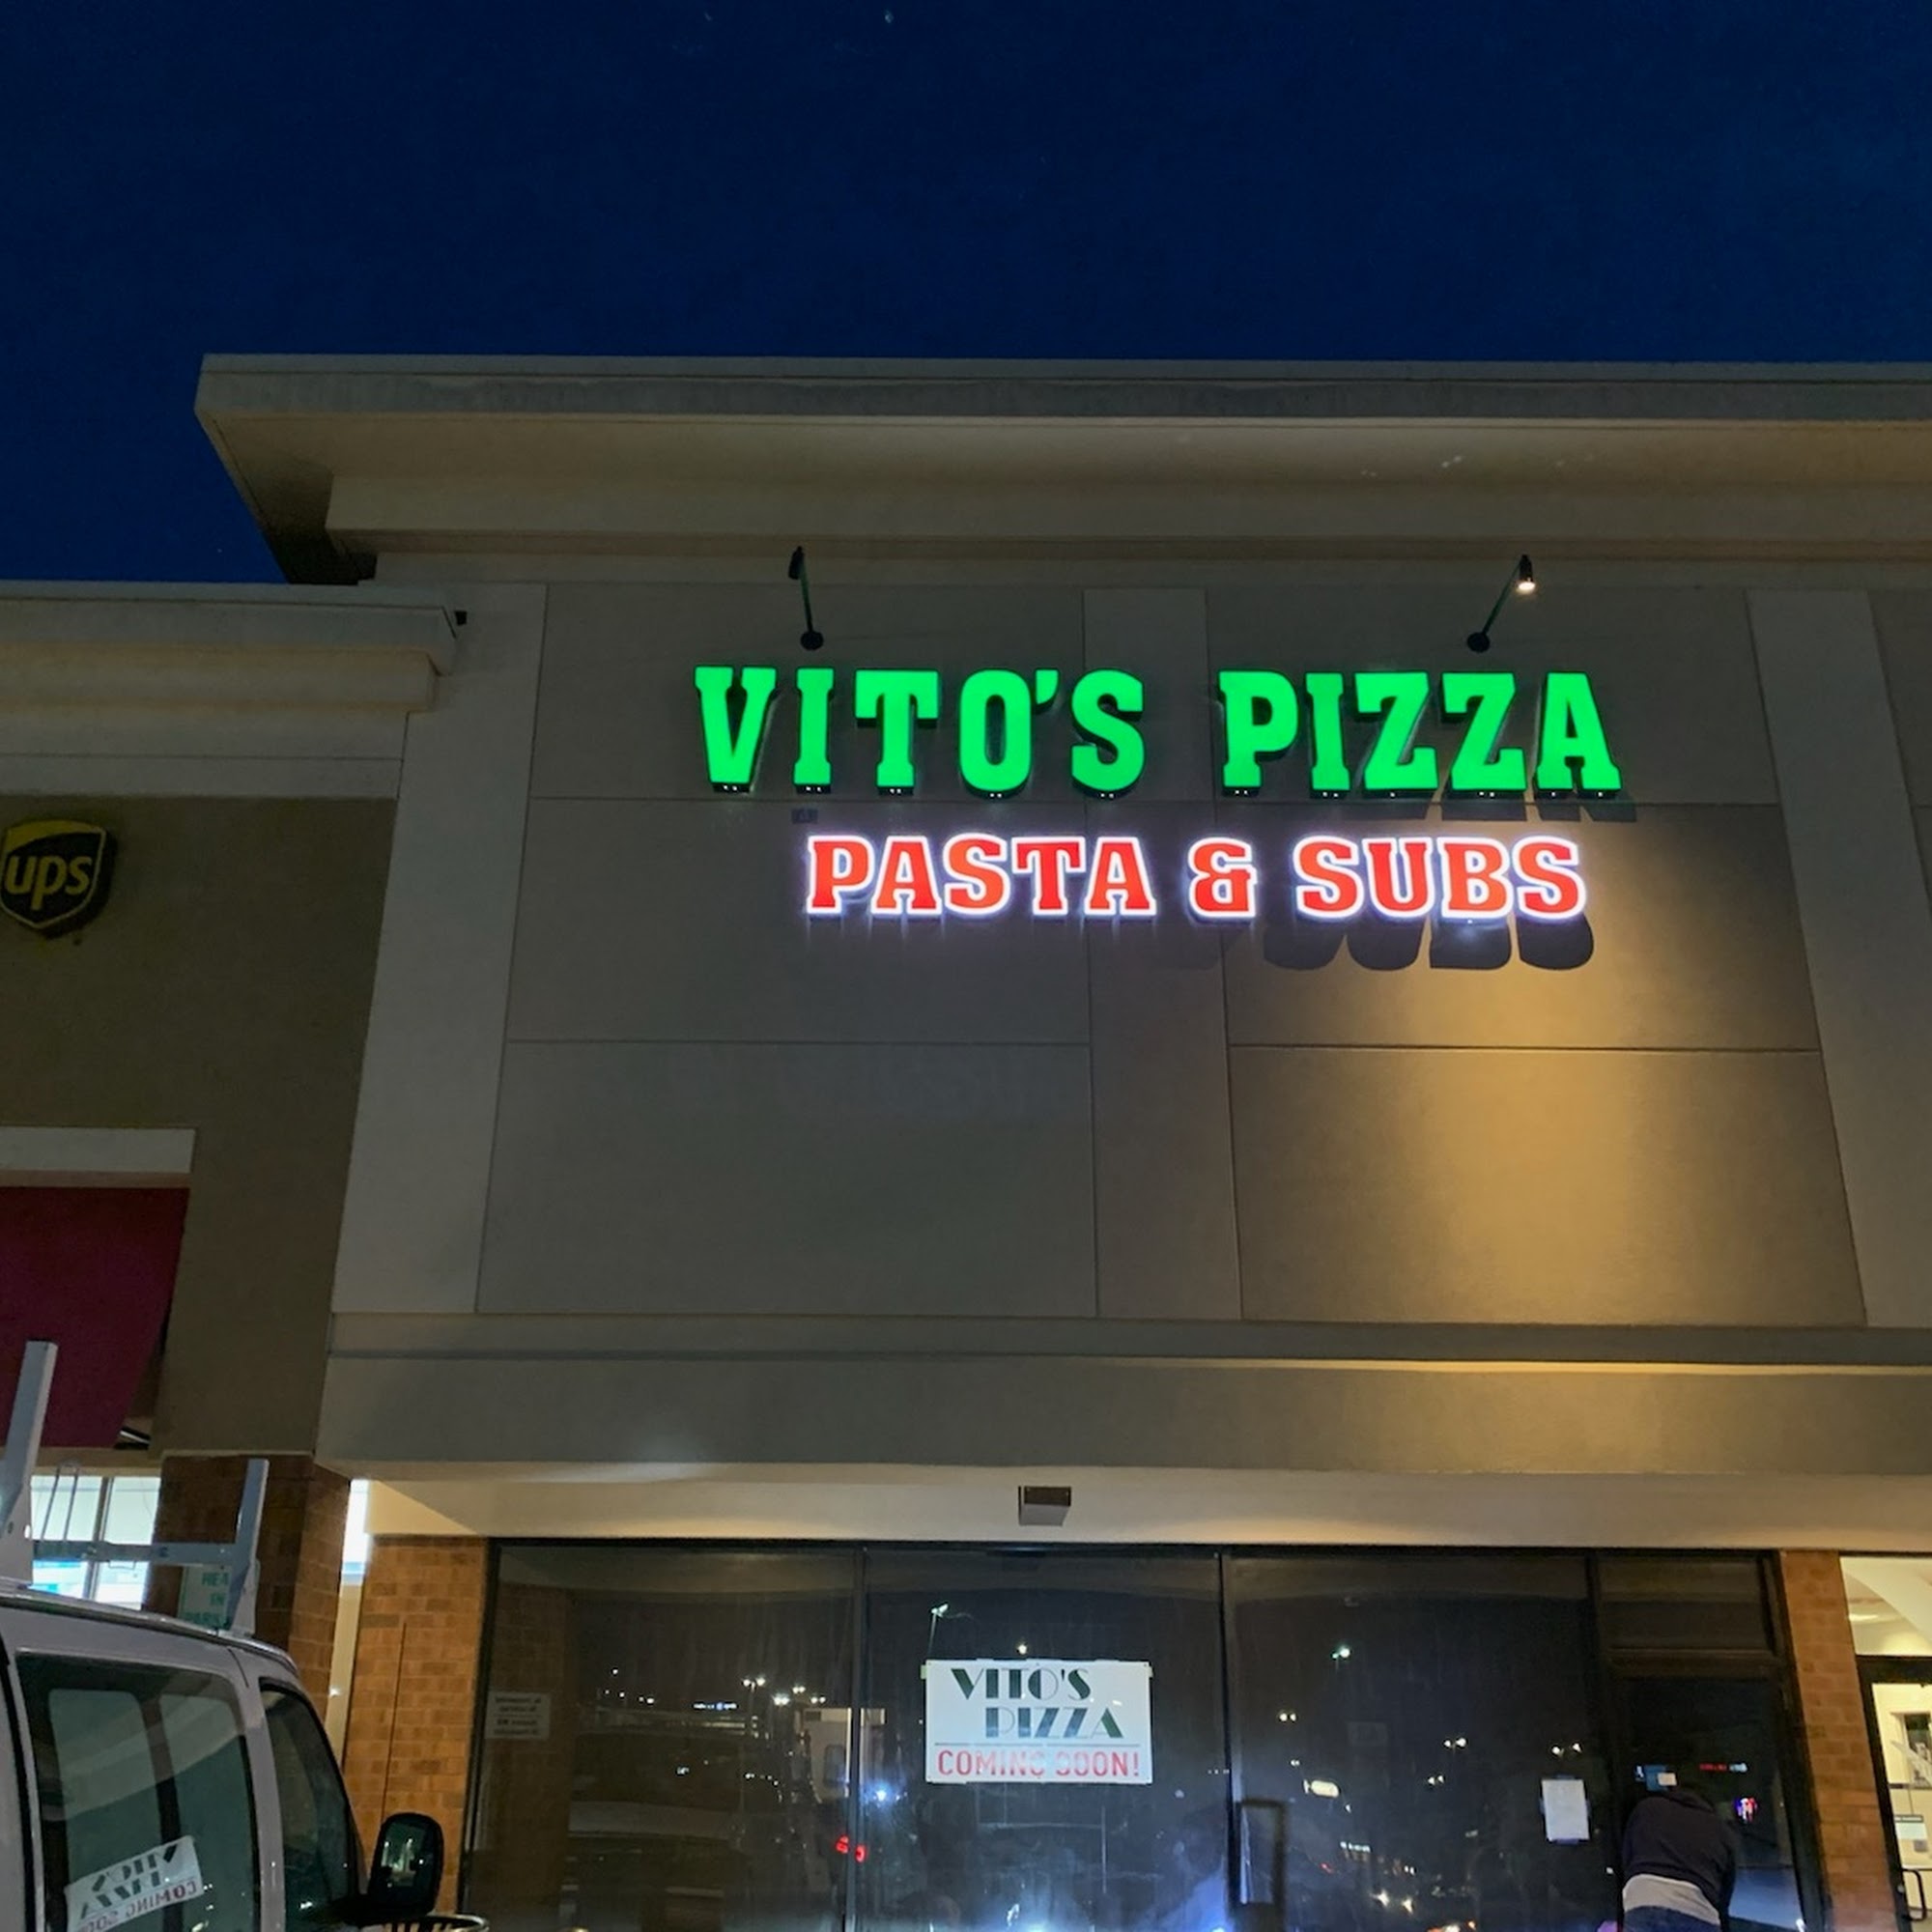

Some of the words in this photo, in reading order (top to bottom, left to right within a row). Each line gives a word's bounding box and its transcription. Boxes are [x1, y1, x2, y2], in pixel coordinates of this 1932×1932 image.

[695, 666, 1145, 795] VITO'S
[1217, 670, 1623, 797] PIZZA
[804, 833, 1158, 919] PASTA
[1187, 838, 1258, 921] &
[1293, 836, 1588, 921] SUBS
[951, 1667, 1092, 1701] VITO'S
[984, 1706, 1124, 1739] PIZZA
